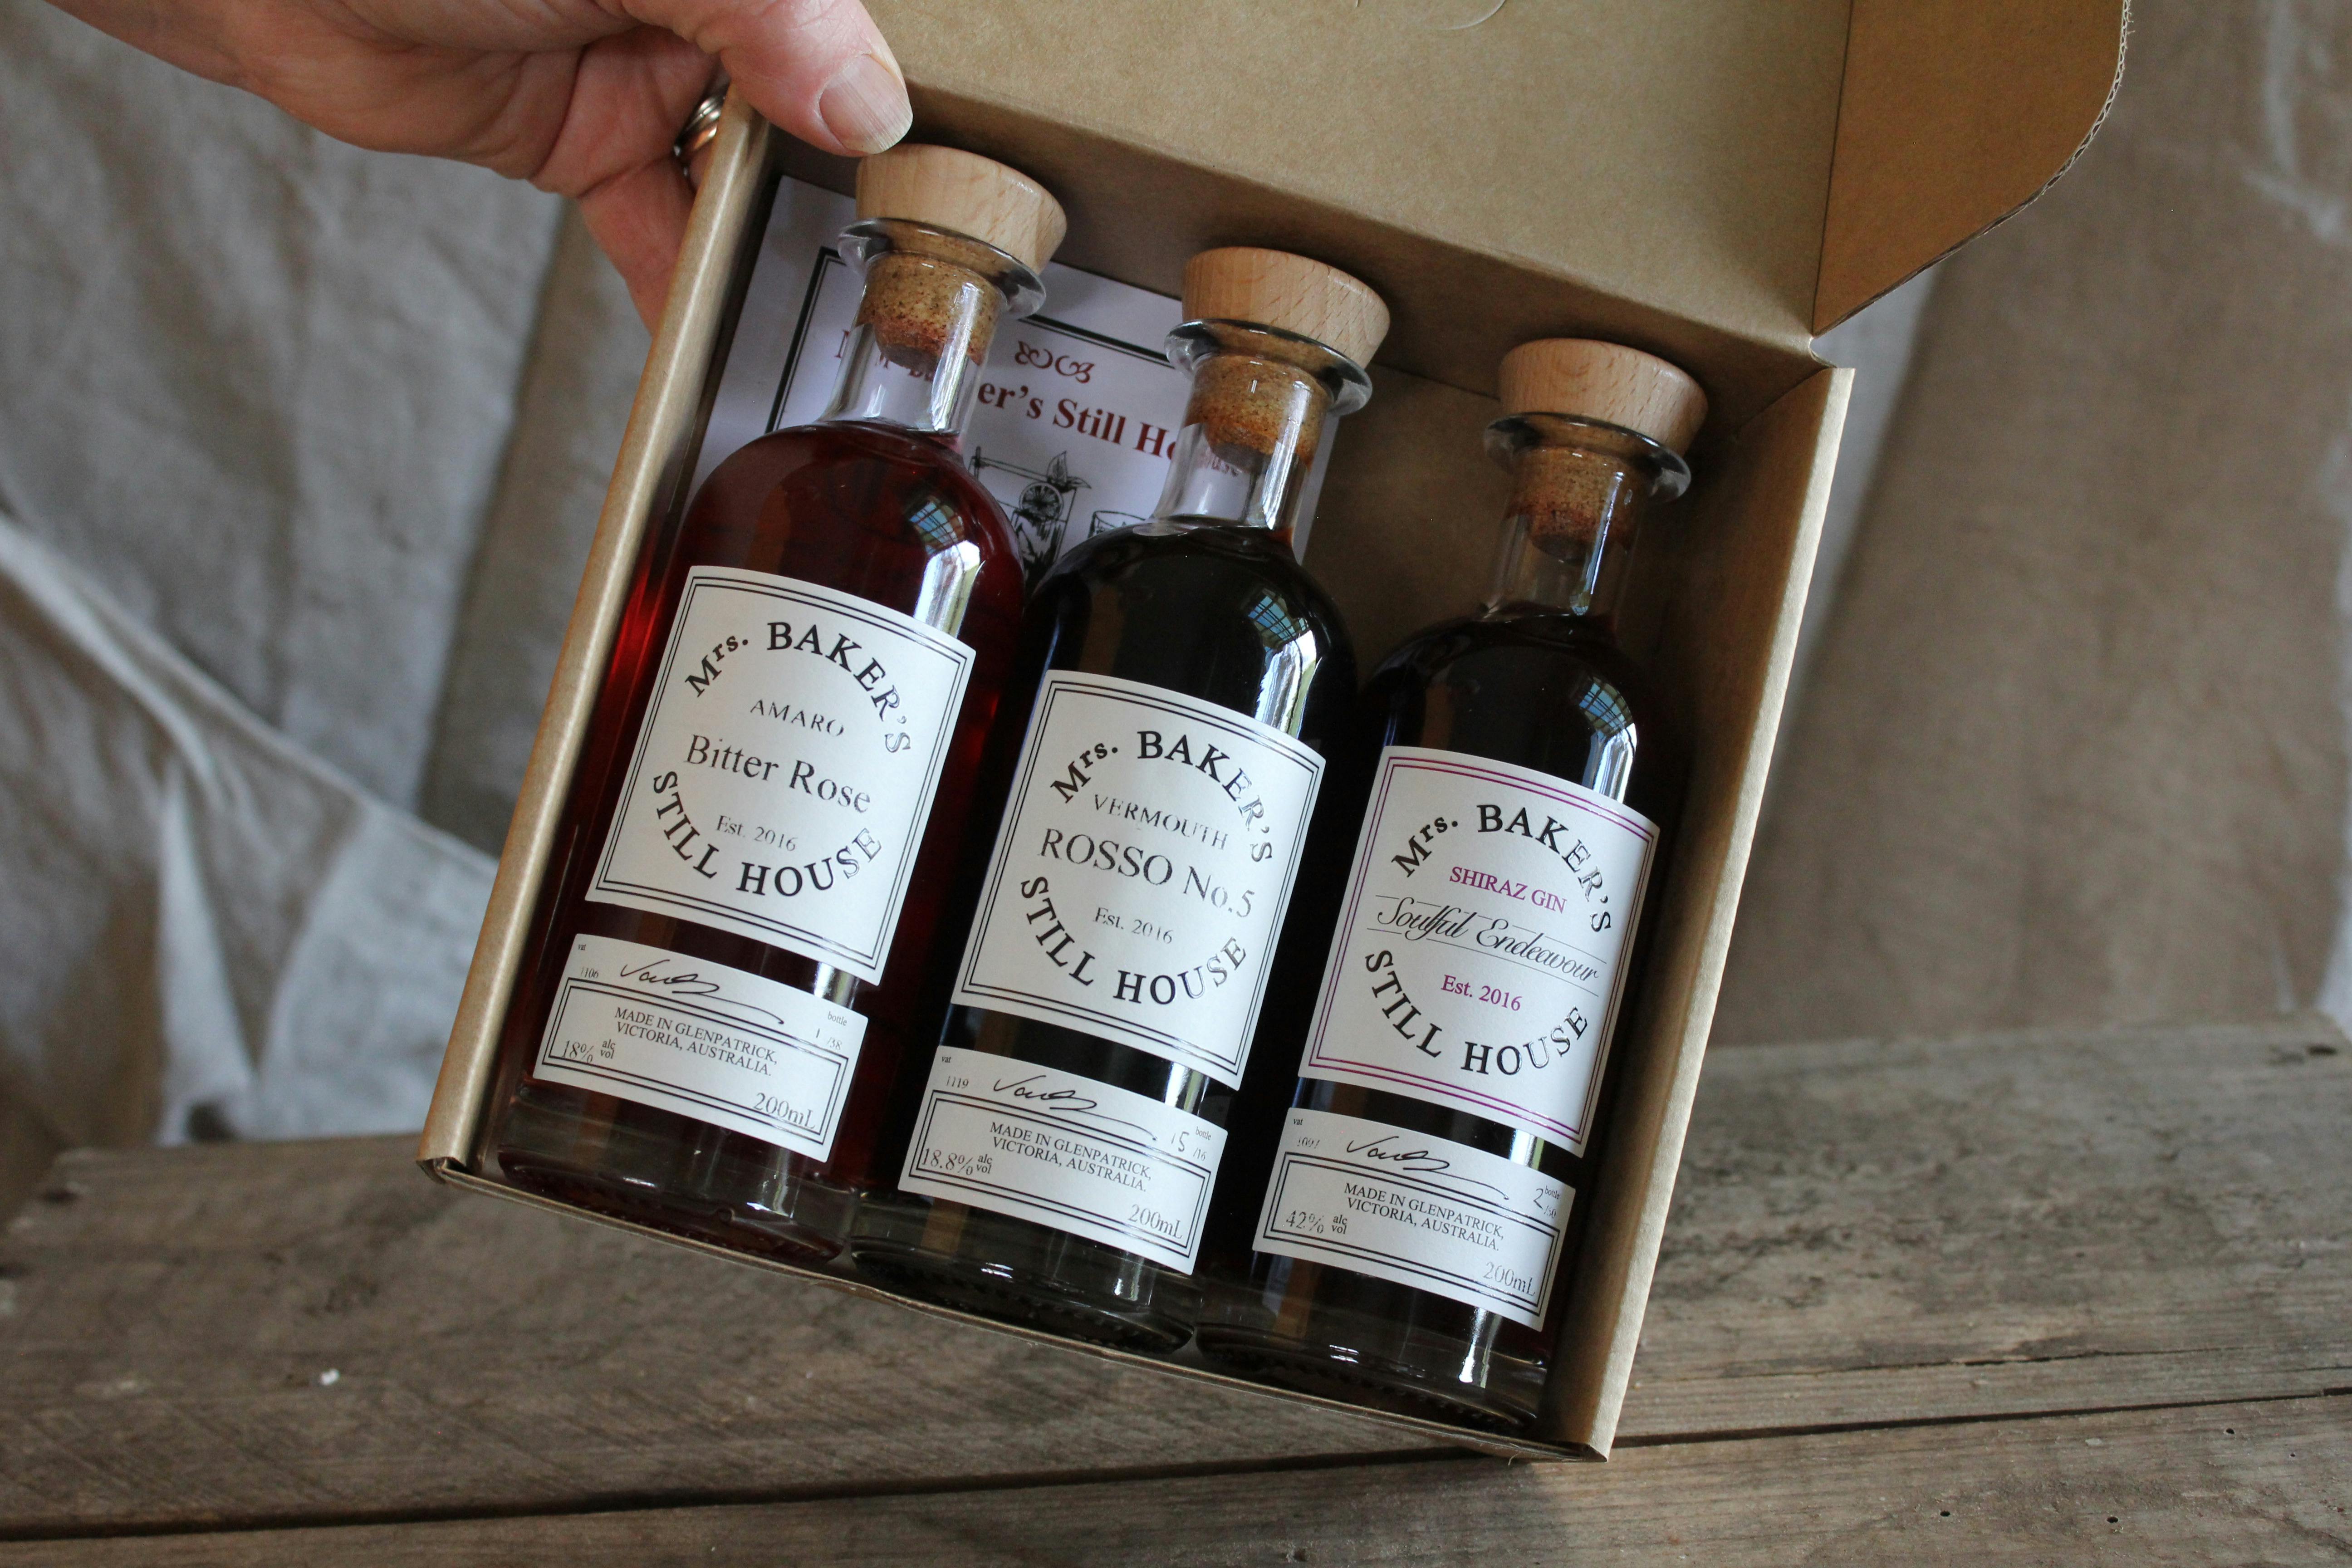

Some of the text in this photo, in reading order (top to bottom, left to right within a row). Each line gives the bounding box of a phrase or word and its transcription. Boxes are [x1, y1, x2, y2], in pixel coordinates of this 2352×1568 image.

[1053, 399, 1126, 445] Still
[685, 622, 911, 753] Mrs. BAKER'S
[750, 699, 844, 737] AMARO
[684, 735, 871, 813] Bitter Rose
[1051, 730, 1272, 862] Mrs. BAKER'S
[653, 771, 882, 897] STILL HOUSE
[716, 815, 797, 852] Est. 2016
[1093, 794, 1228, 850] VERMOUTH
[1040, 828, 1172, 886] ROSSO
[1391, 804, 1611, 933] Mrs. BAKER'S
[1449, 867, 1567, 914] SHIRAZ GIN
[1021, 876, 1247, 1004] STILL HOUSE
[1093, 907, 1173, 944] Est. 2016
[1377, 896, 1599, 982] Soulful Endeavour
[1441, 975, 1523, 1012] Est. 2016
[828, 1011, 847, 1026] bottle
[1365, 950, 1588, 1075] STILL HOUSE
[562, 1040, 594, 1063] 18%
[601, 1050, 614, 1058] vol
[603, 1039, 615, 1049] alc
[615, 1007, 777, 1066] MADE IN GLENPATRICK,
[616, 1022, 771, 1076] VICTORIA, AUSTRALIA.
[946, 1075, 969, 1088] 1119
[753, 1093, 815, 1129] 200mL
[990, 1122, 1152, 1181] MADE IN GLENPATRICK,
[1196, 1126, 1211, 1141] bottle
[922, 1148, 973, 1175] 18.8%
[976, 1164, 991, 1174] vol
[978, 1154, 993, 1164] alc
[992, 1137, 1147, 1192] VICTORIA, AUSTRALIA.
[1344, 1183, 1504, 1240] MADE IN GLENPATRICK,
[1545, 1186, 1560, 1200] bottle
[1127, 1204, 1182, 1240] 200mL
[1286, 1210, 1324, 1234] 42%
[1332, 1225, 1347, 1234] vol
[1333, 1215, 1348, 1225] alc
[1347, 1197, 1499, 1252] VICTORIA, AUSTRALIA.
[1483, 1261, 1535, 1297] 200mL
